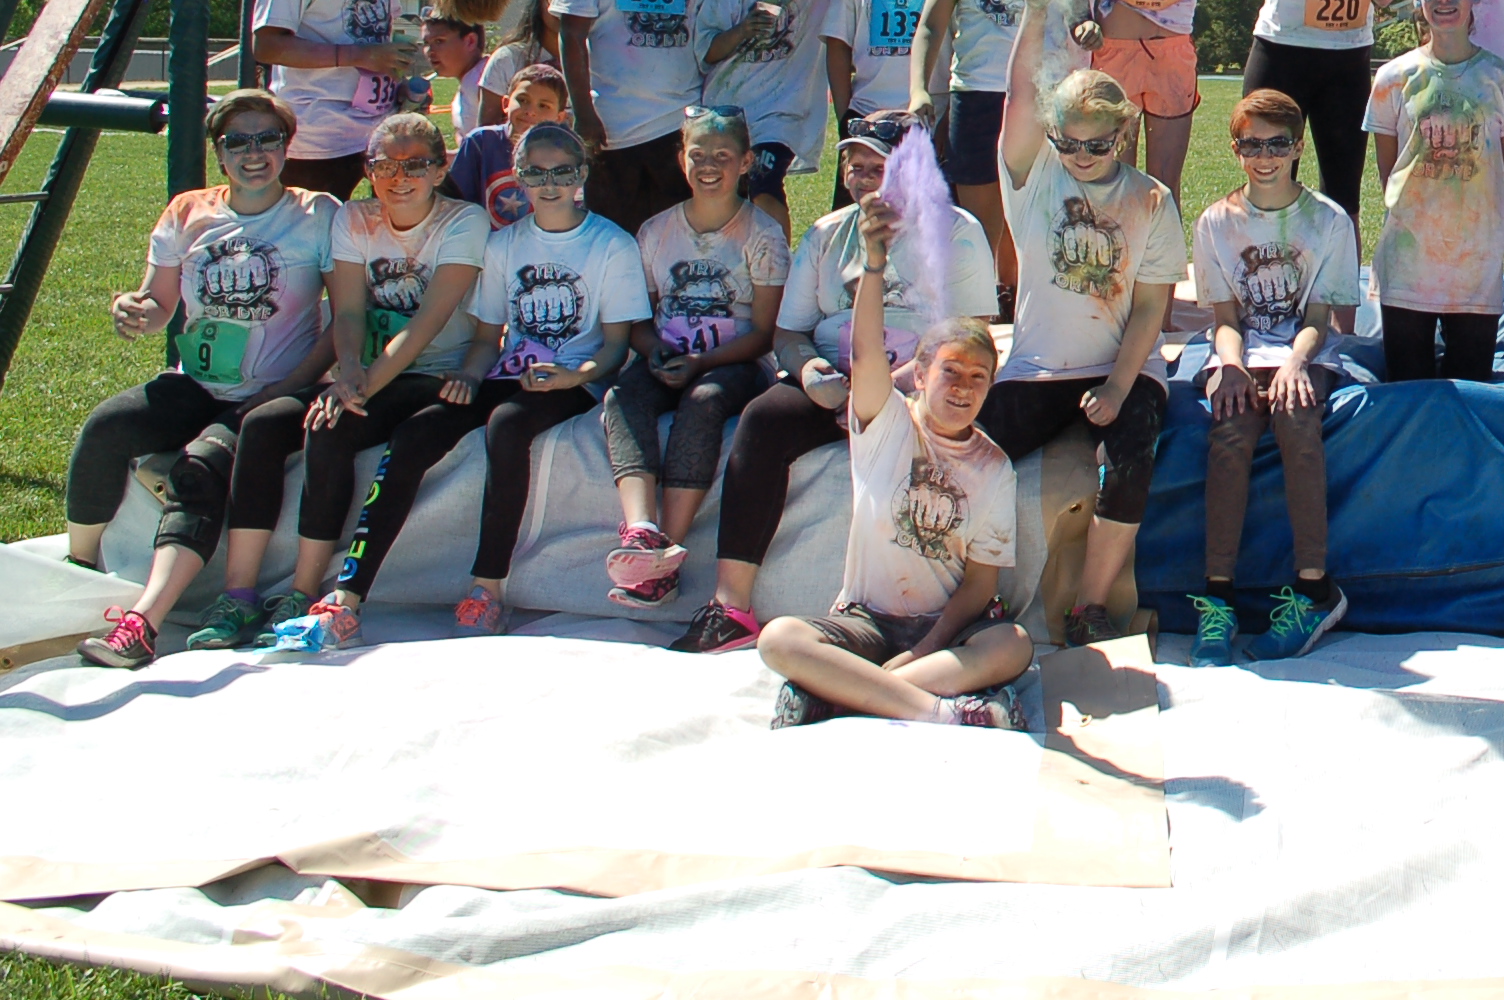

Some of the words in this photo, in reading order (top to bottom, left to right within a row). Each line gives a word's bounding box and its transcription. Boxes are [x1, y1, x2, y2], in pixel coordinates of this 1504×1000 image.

[631, 32, 656, 47] OR
[663, 33, 687, 47] DYE
[1257, 244, 1285, 259] TRY
[533, 264, 562, 280] TRY
[687, 261, 717, 276] TRY
[1055, 272, 1082, 293] OR
[204, 304, 230, 319] OR
[237, 305, 273, 321] DYE
[676, 323, 720, 355] 341
[198, 342, 212, 372] 9
